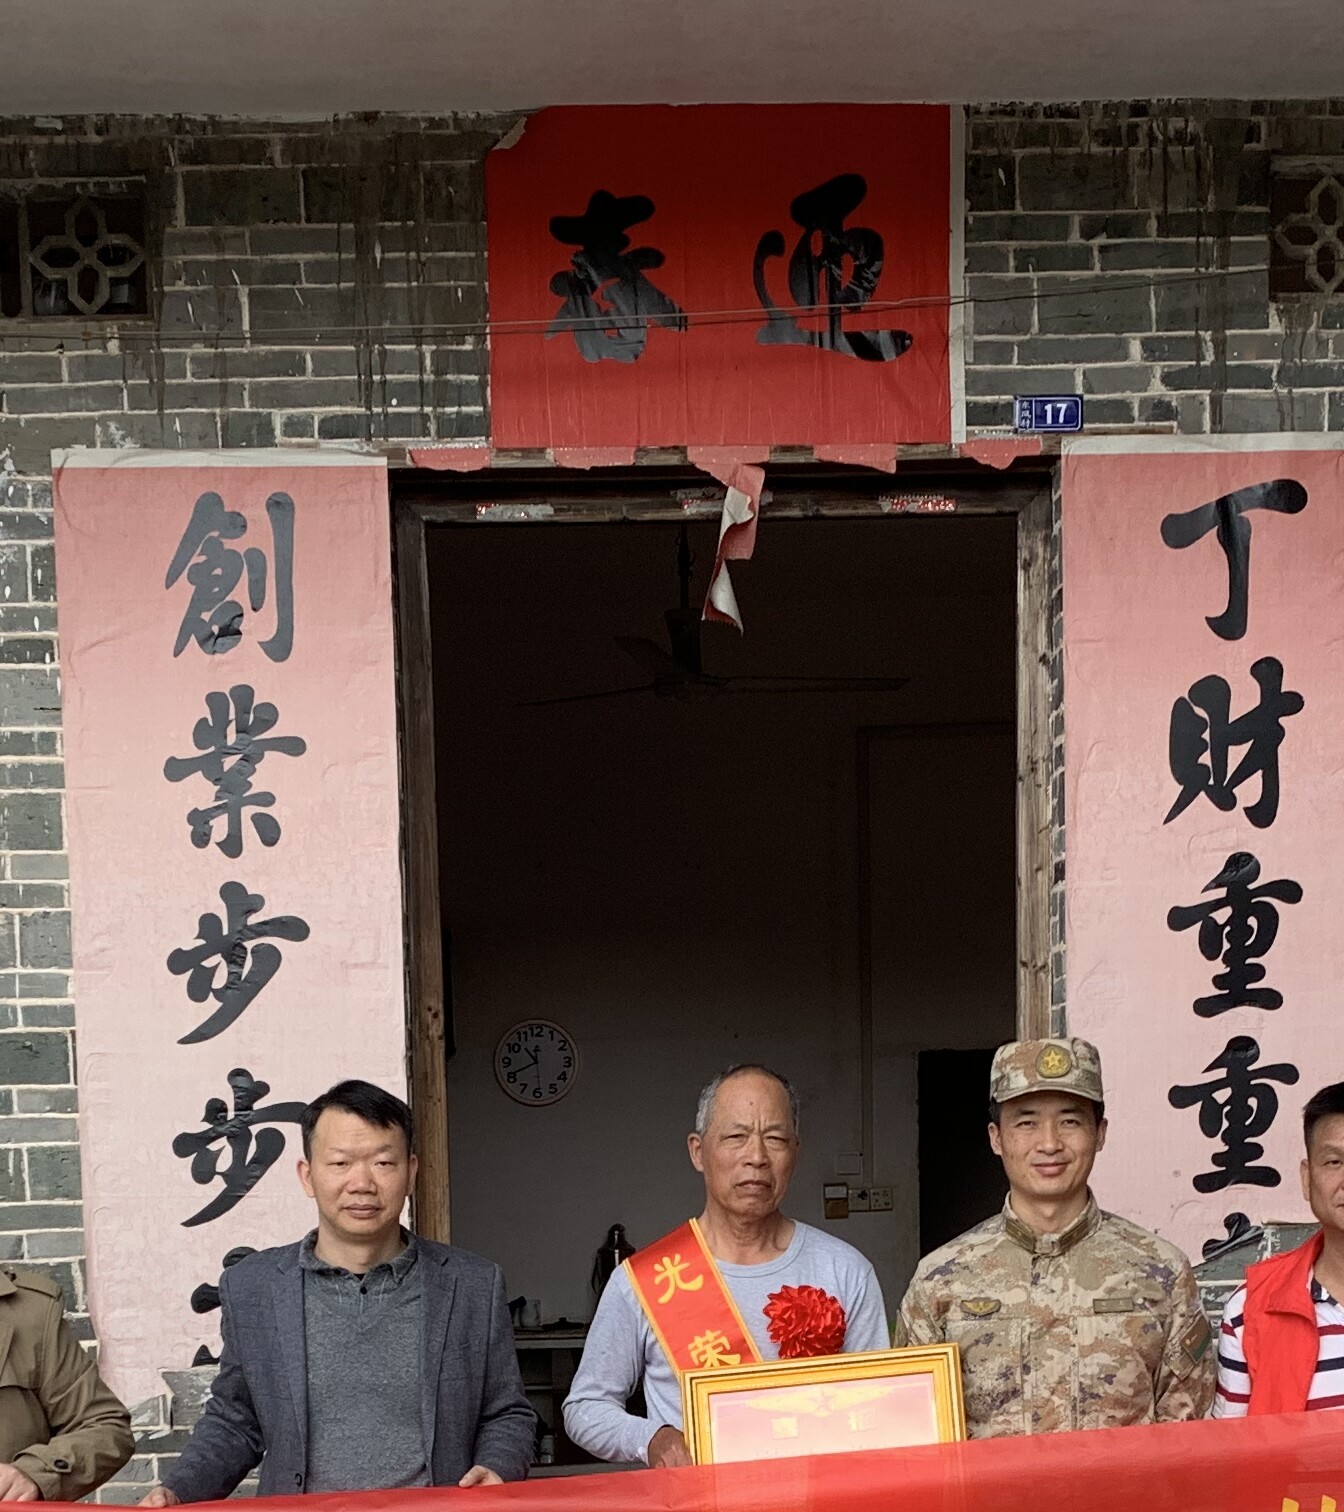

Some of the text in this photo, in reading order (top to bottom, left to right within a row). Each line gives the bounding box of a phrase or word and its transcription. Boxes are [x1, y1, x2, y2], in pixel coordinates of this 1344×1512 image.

[1044, 403, 1068, 425] 17
[1160, 478, 1308, 1262] 丁財重重
[516, 1031, 528, 1042] 11
[528, 1026, 544, 1038] 12
[549, 1030, 554, 1041] 1
[506, 1042, 521, 1053] 10
[557, 1040, 568, 1051] 2
[502, 1056, 512, 1069] 9
[563, 1056, 572, 1068] 3
[507, 1071, 517, 1084] 8
[557, 1070, 568, 1083] 4
[519, 1082, 528, 1094] 7
[532, 1087, 543, 1099] 6
[548, 1083, 558, 1095] 5
[654, 1253, 742, 1369] 光荣
